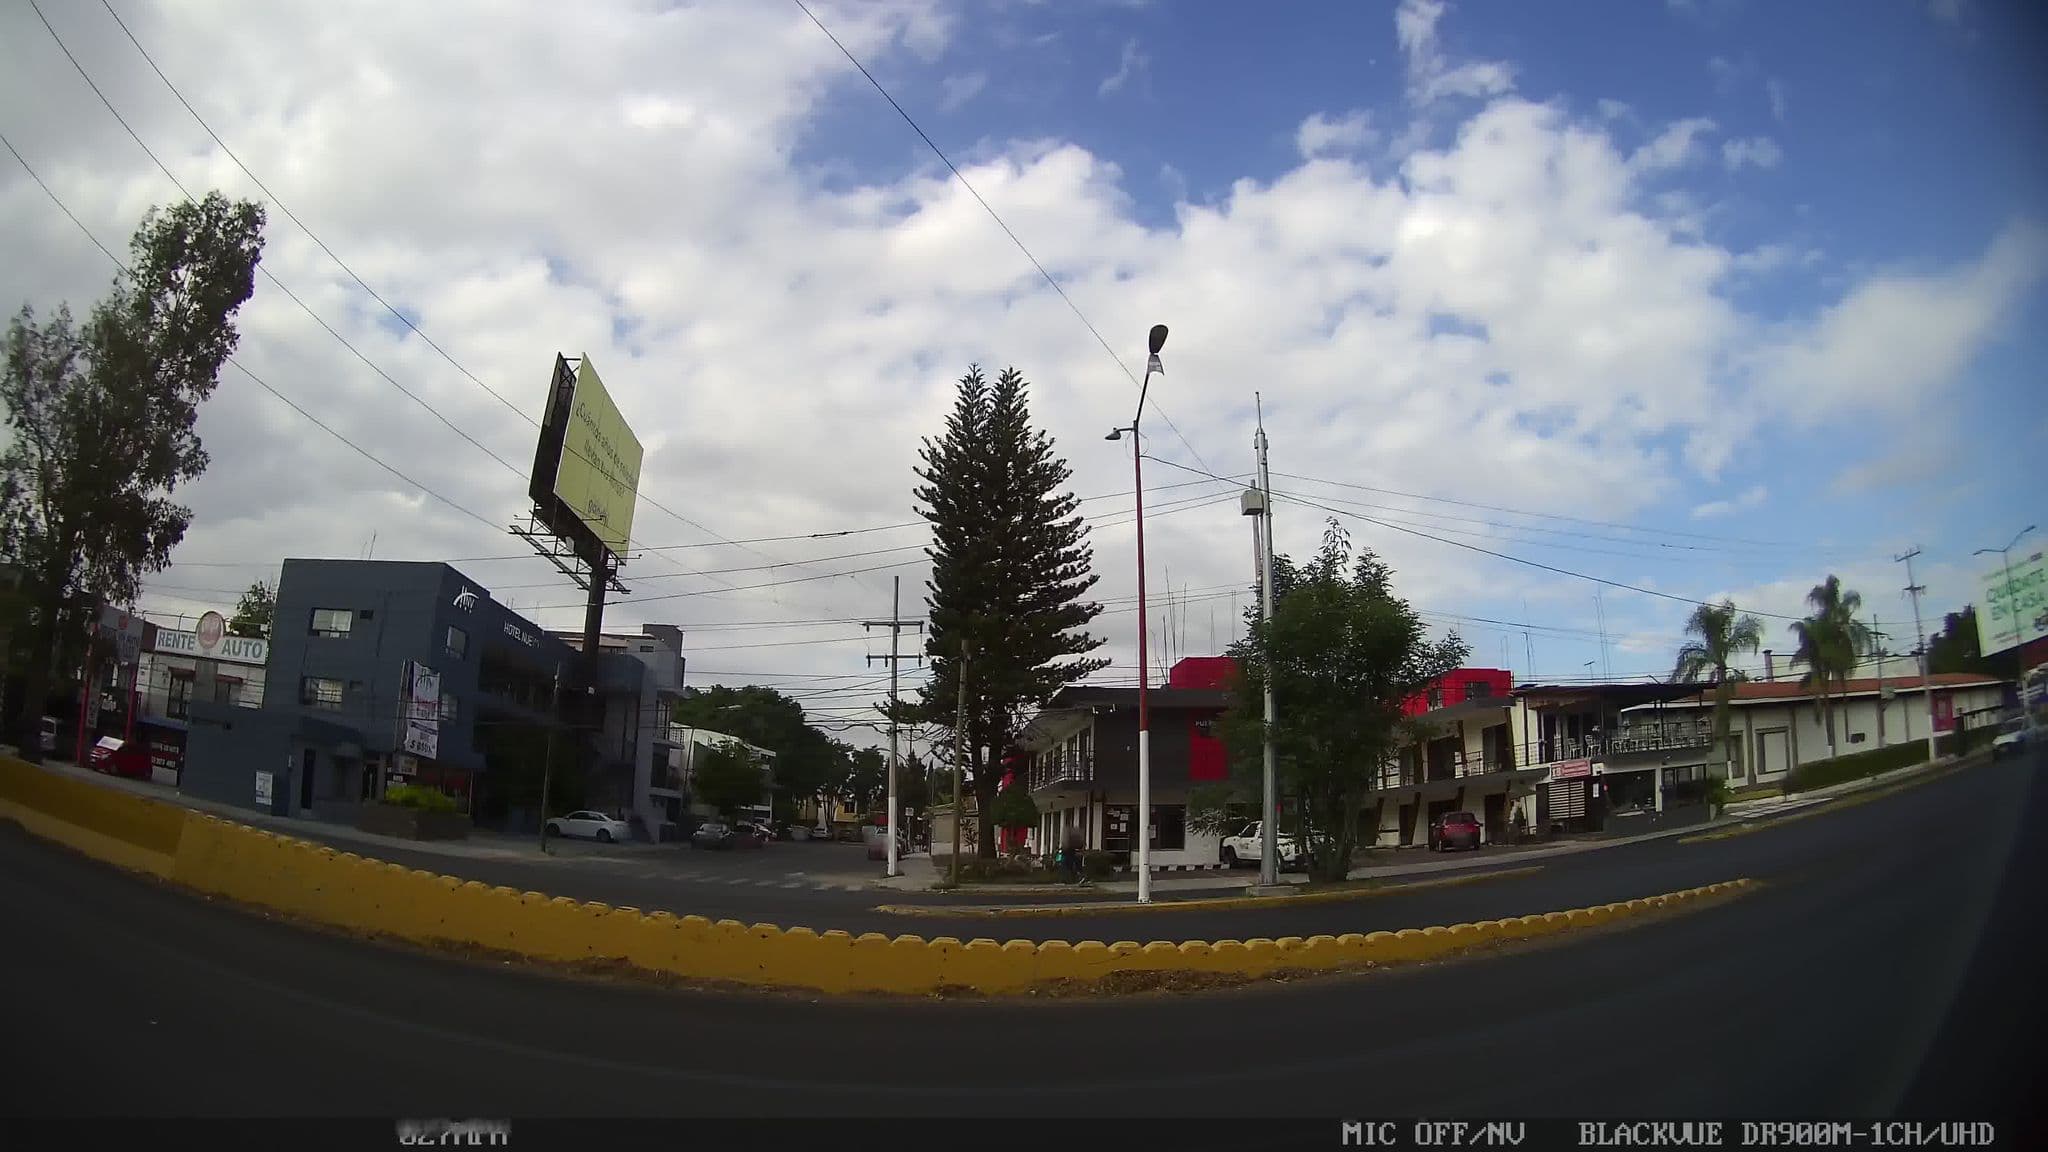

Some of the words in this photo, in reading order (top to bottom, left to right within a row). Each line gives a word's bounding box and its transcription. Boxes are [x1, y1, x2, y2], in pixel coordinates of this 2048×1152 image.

[504, 621, 521, 640] HOTEL
[157, 631, 196, 651] RENTE
[221, 639, 263, 659] AUTO
